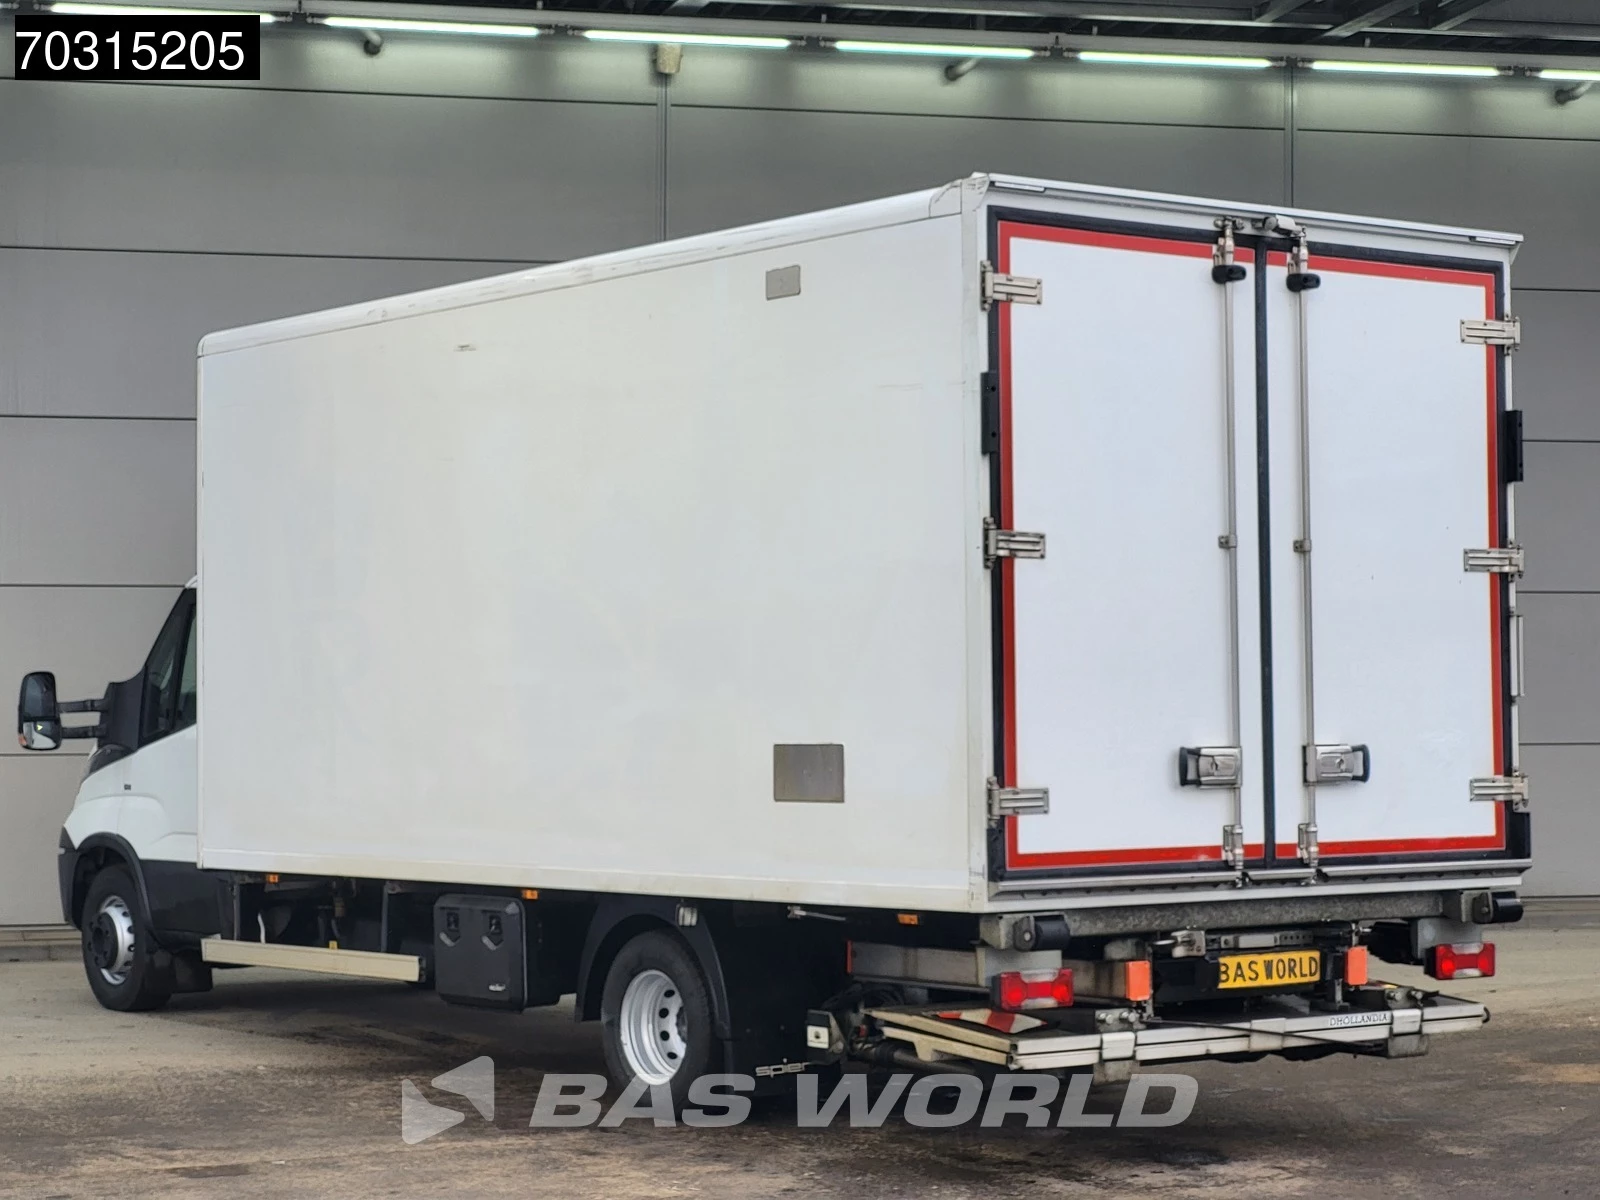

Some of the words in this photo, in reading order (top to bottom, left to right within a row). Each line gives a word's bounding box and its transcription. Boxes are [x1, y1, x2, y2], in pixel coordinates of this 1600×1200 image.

[1219, 960, 1259, 983] BAS
[1263, 956, 1319, 980] WORLD
[1329, 1013, 1388, 1026] DHOLLANDIA
